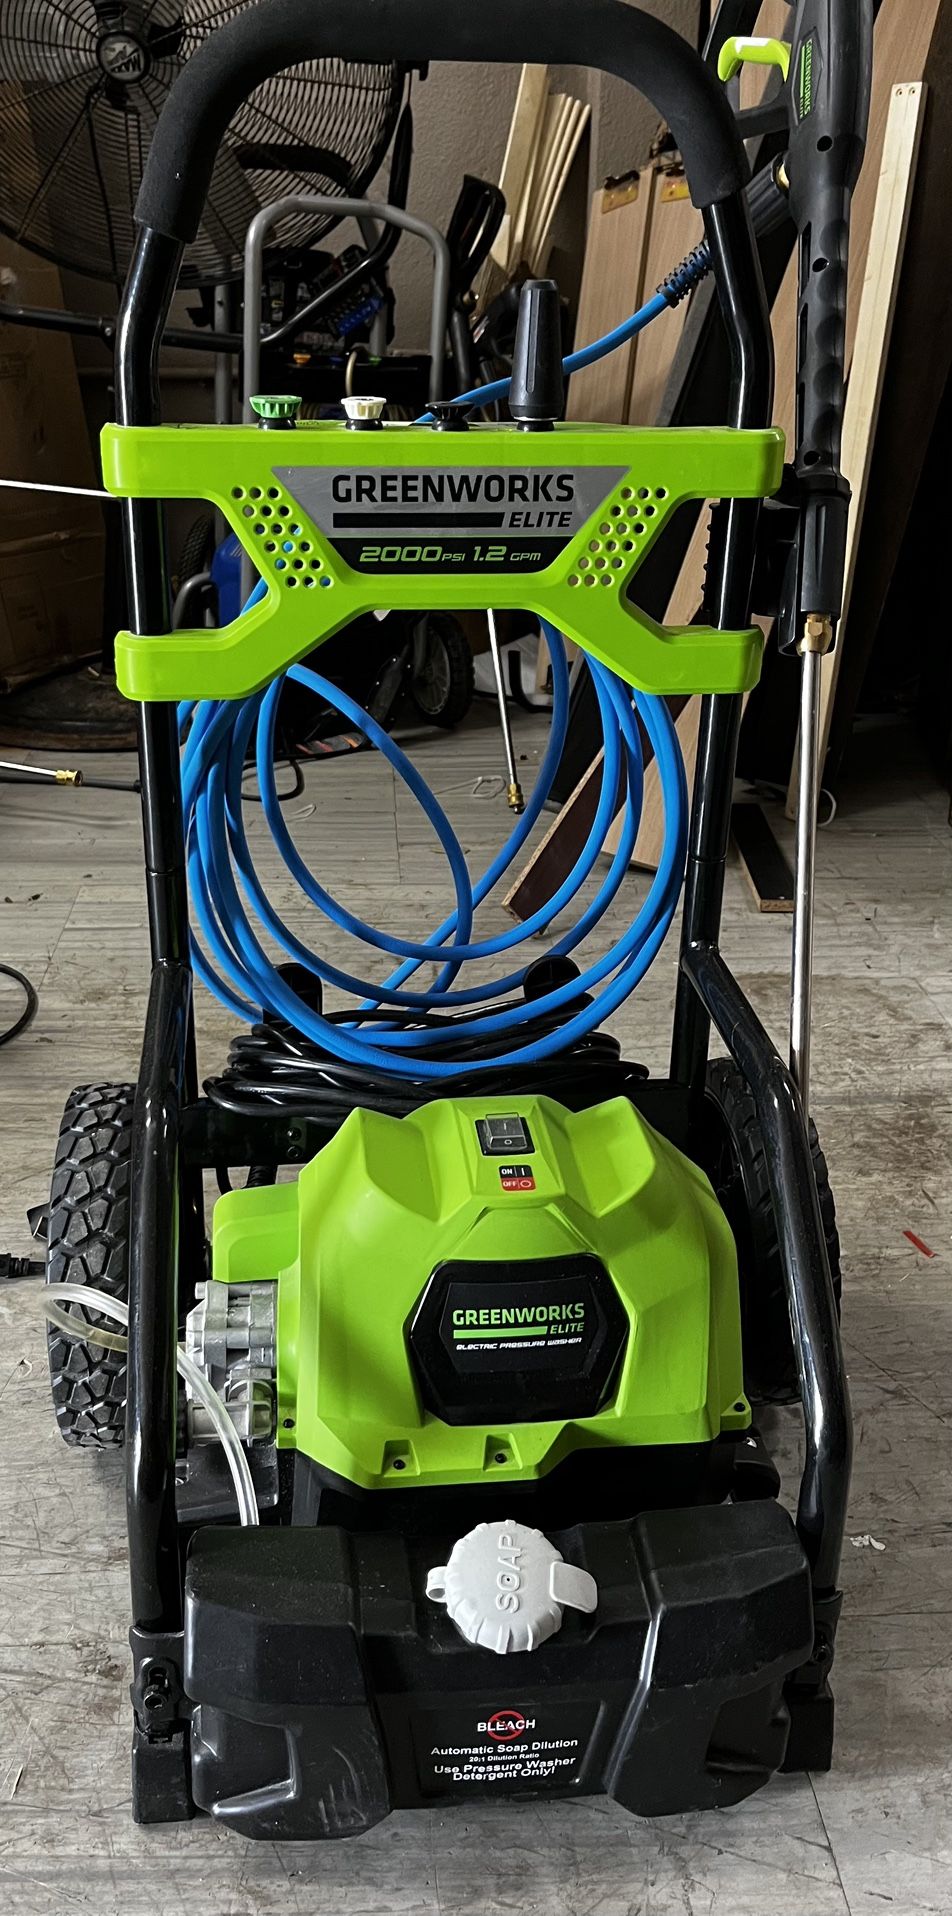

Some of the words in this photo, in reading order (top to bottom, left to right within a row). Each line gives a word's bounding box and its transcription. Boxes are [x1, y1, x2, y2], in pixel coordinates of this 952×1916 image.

[804, 38, 813, 116] GREENWORKS
[332, 474, 574, 503] GREENWORKS
[508, 511, 573, 528] ELITE
[473, 545, 507, 562] 1.2
[510, 552, 541, 562] GPM
[453, 1303, 585, 1326] GREENWORKS
[550, 1322, 585, 1335] ELITE
[456, 1342, 498, 1351] ELECTRIC
[499, 1340, 546, 1349] PRESSURE
[547, 1337, 582, 1346] WASHER
[496, 1534, 523, 1614] SOAP
[477, 1719, 536, 1732] BLEACH
[431, 1745, 494, 1755] Automatic
[497, 1744, 529, 1753] Soap
[531, 1739, 578, 1750] Dilution
[434, 1765, 460, 1774] Use
[463, 1763, 523, 1773] Pressure
[526, 1757, 576, 1769] Washer
[487, 1754, 518, 1762] Dilution
[519, 1752, 540, 1760] Ratio
[453, 1770, 518, 1781] Detergent
[520, 1766, 556, 1777] Only!
